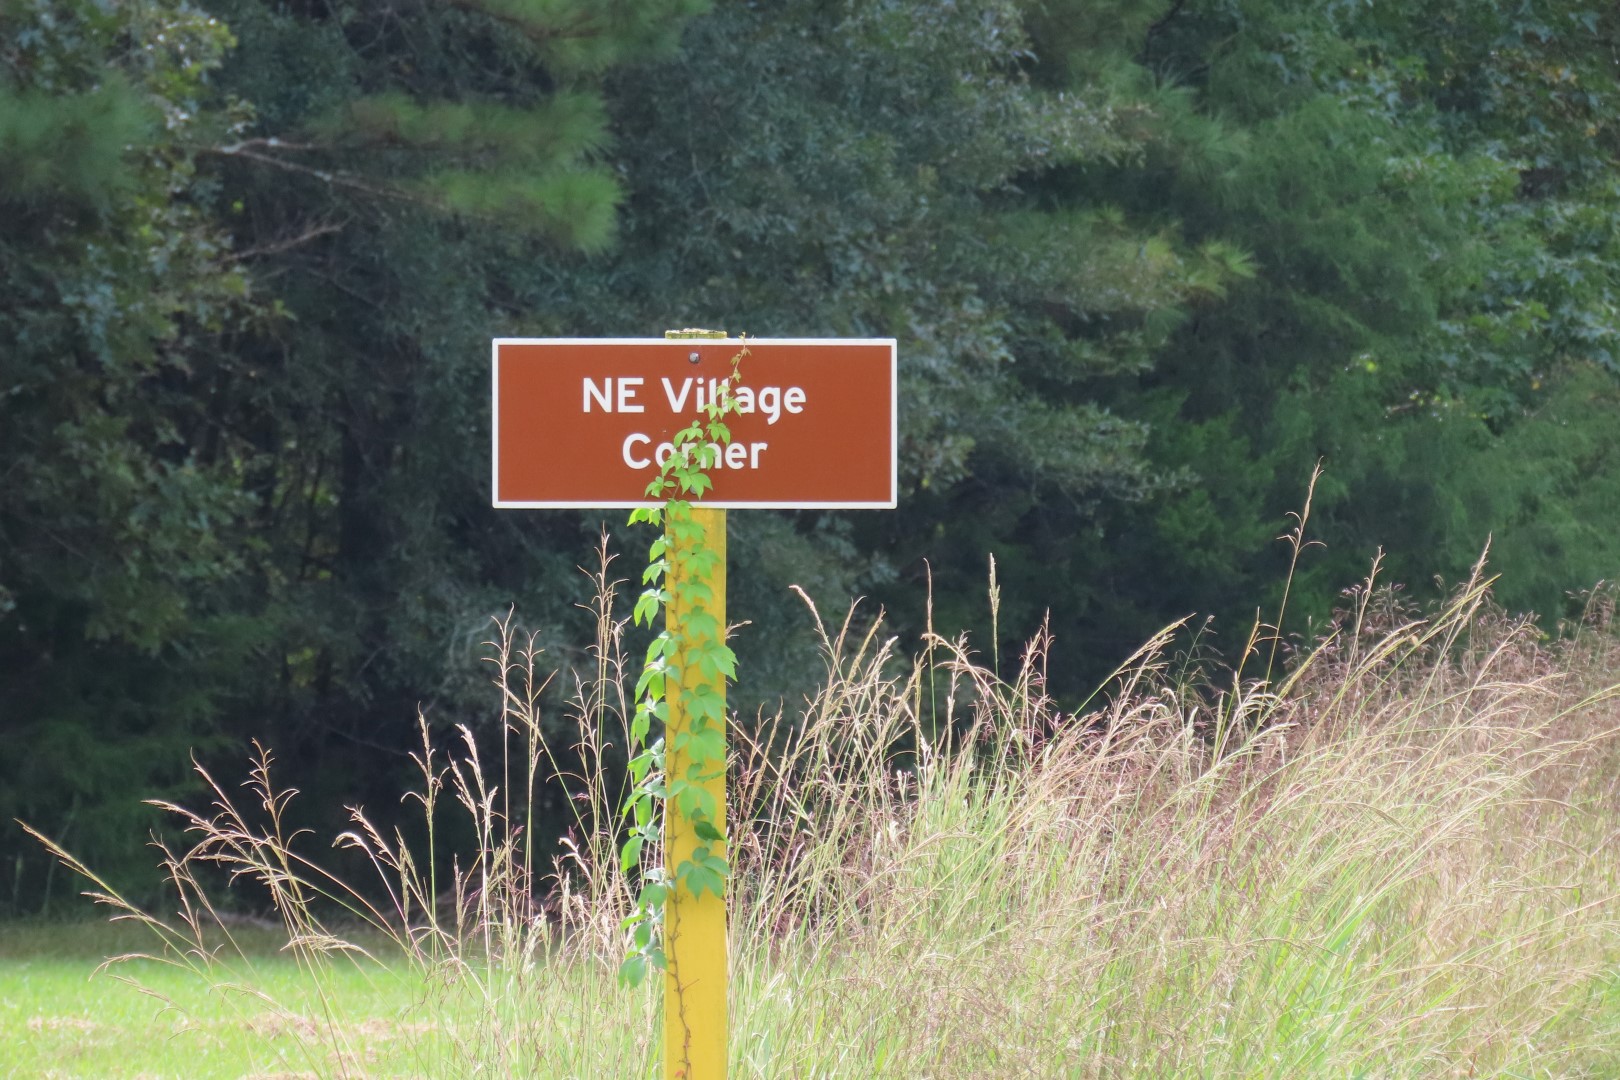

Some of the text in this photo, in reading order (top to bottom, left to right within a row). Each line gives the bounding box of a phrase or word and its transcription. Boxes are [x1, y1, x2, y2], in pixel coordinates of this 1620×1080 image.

[583, 377, 807, 425] NE Village
[622, 432, 768, 470] Corner
